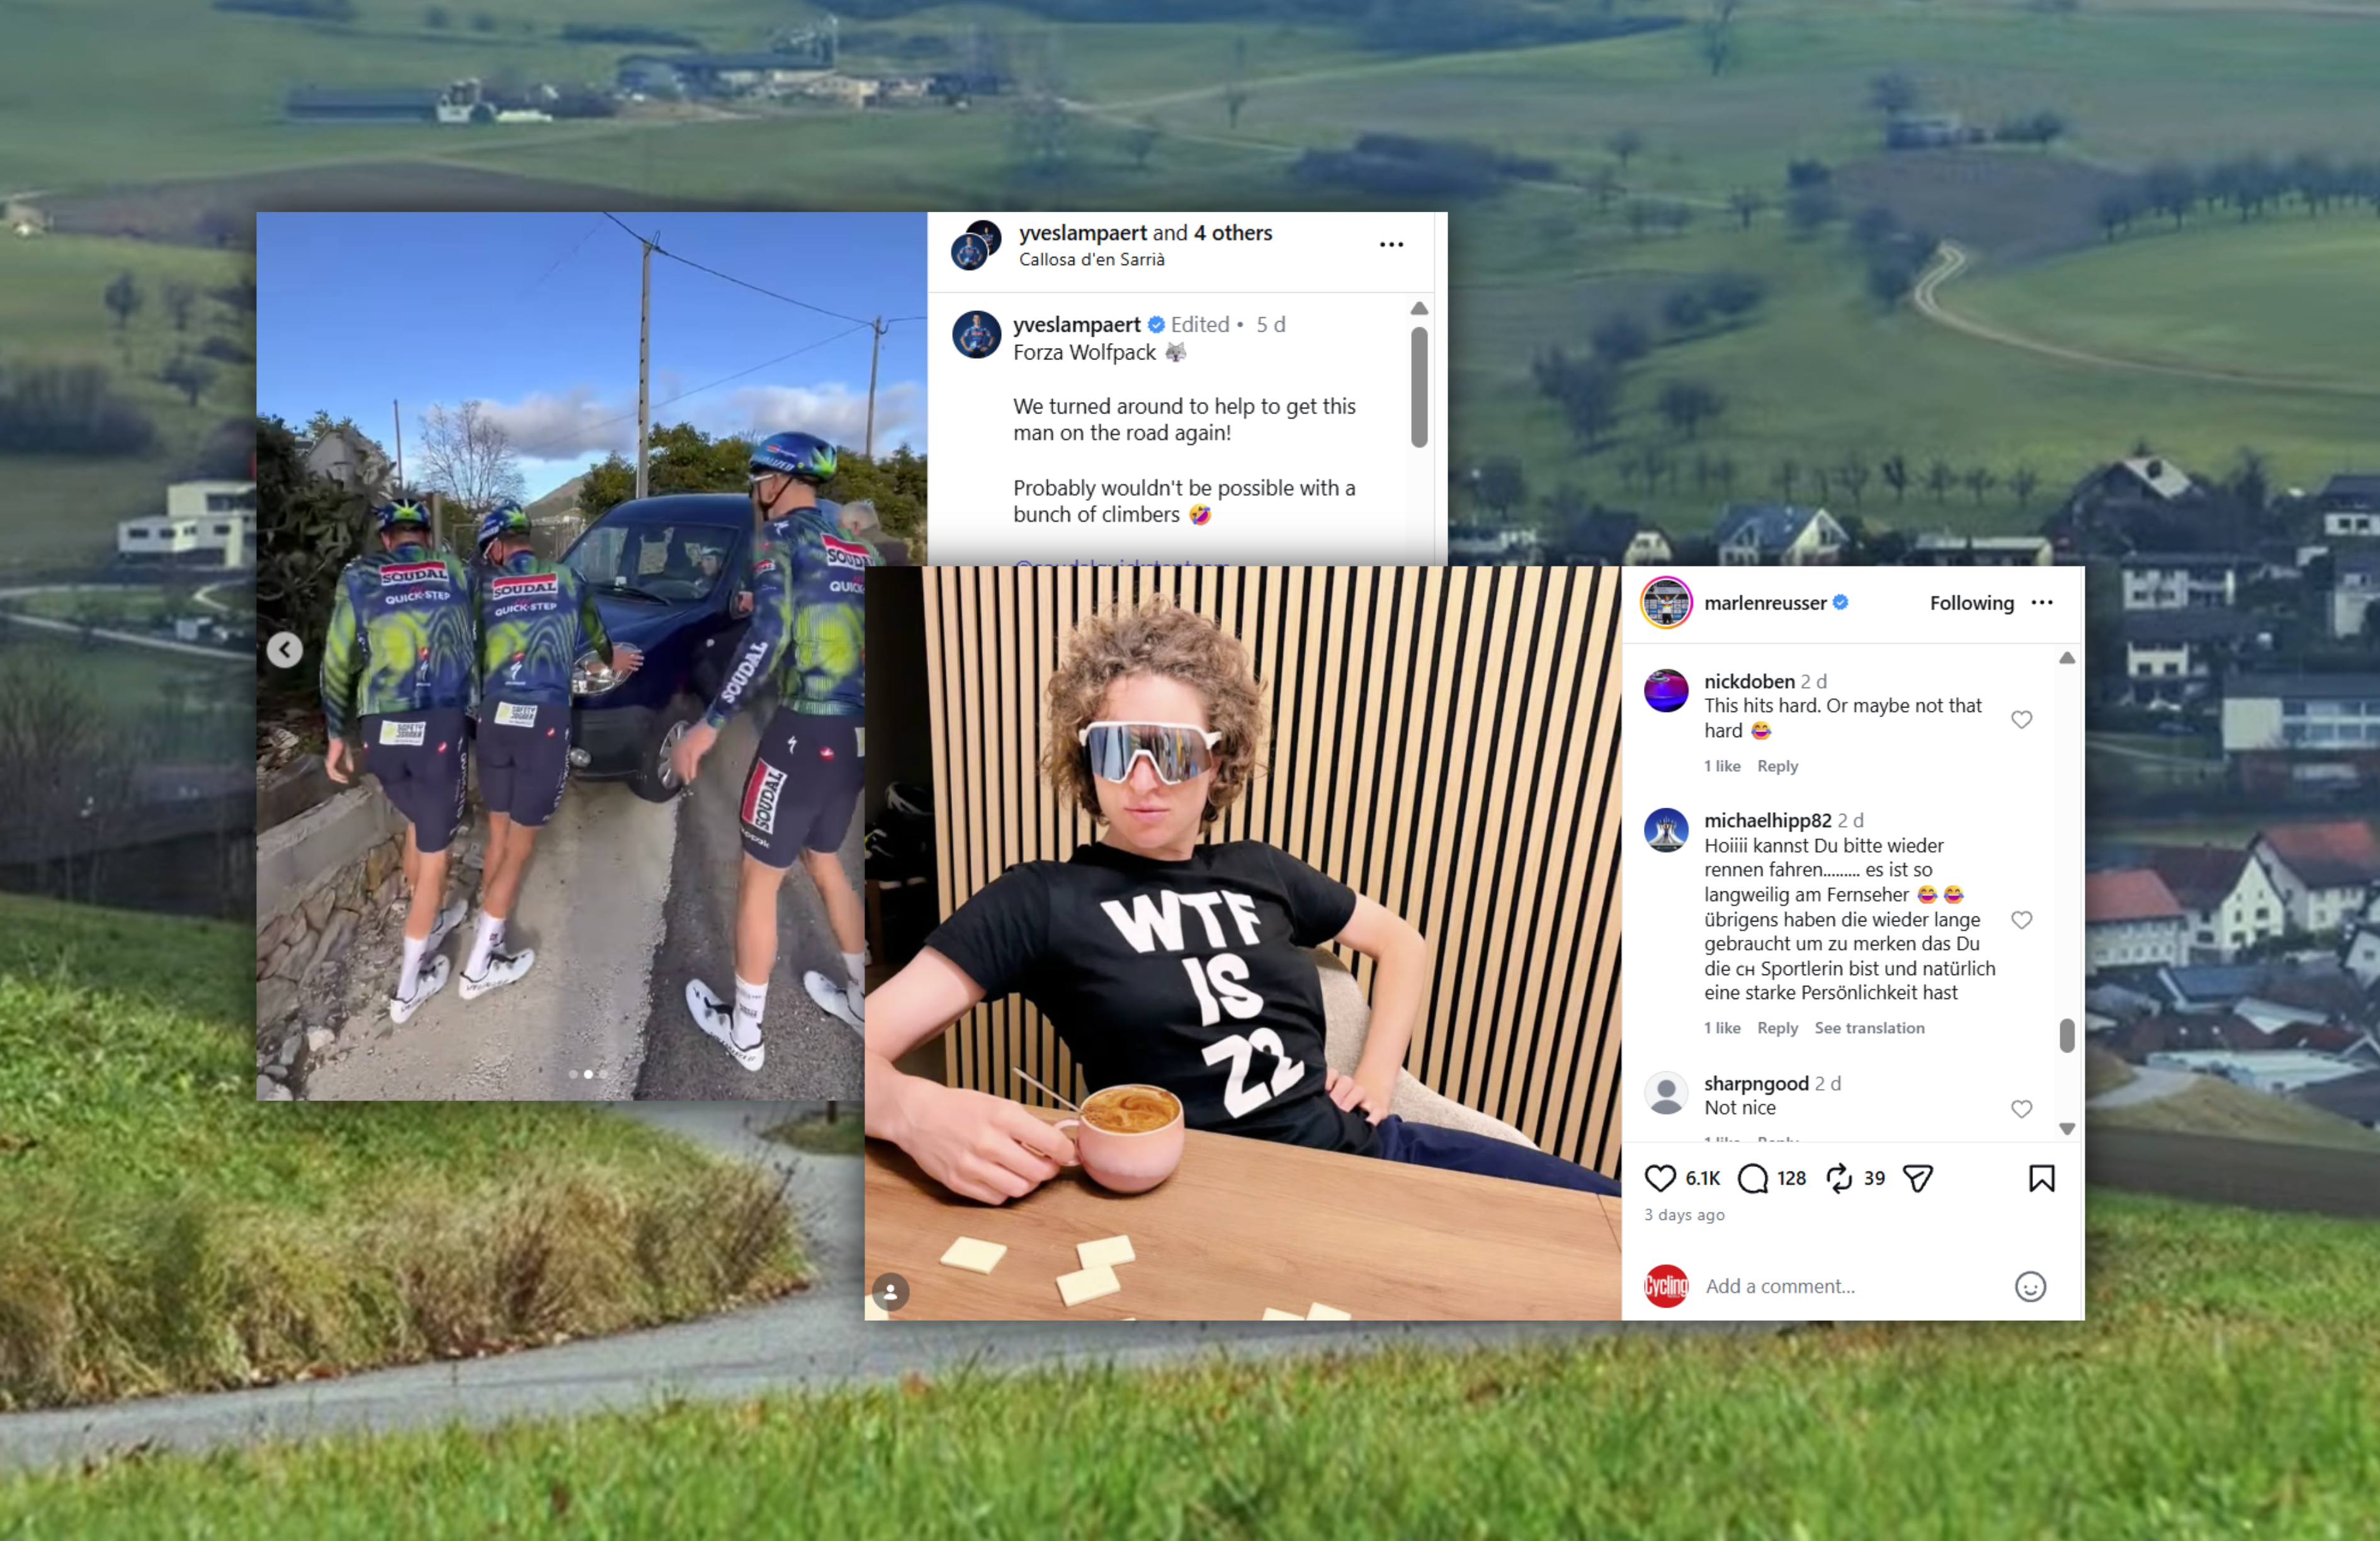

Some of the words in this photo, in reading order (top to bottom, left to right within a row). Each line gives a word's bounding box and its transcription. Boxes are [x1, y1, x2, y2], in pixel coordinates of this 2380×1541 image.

[383, 569, 447, 583] SOUDAL
[494, 583, 557, 598] SOUDAL
[721, 641, 768, 704] SOUDAL
[756, 772, 784, 831] SOUDAL
[1101, 890, 1261, 952] WTF
[1181, 953, 1262, 1026] IS
[1201, 1027, 1305, 1119] Z2
